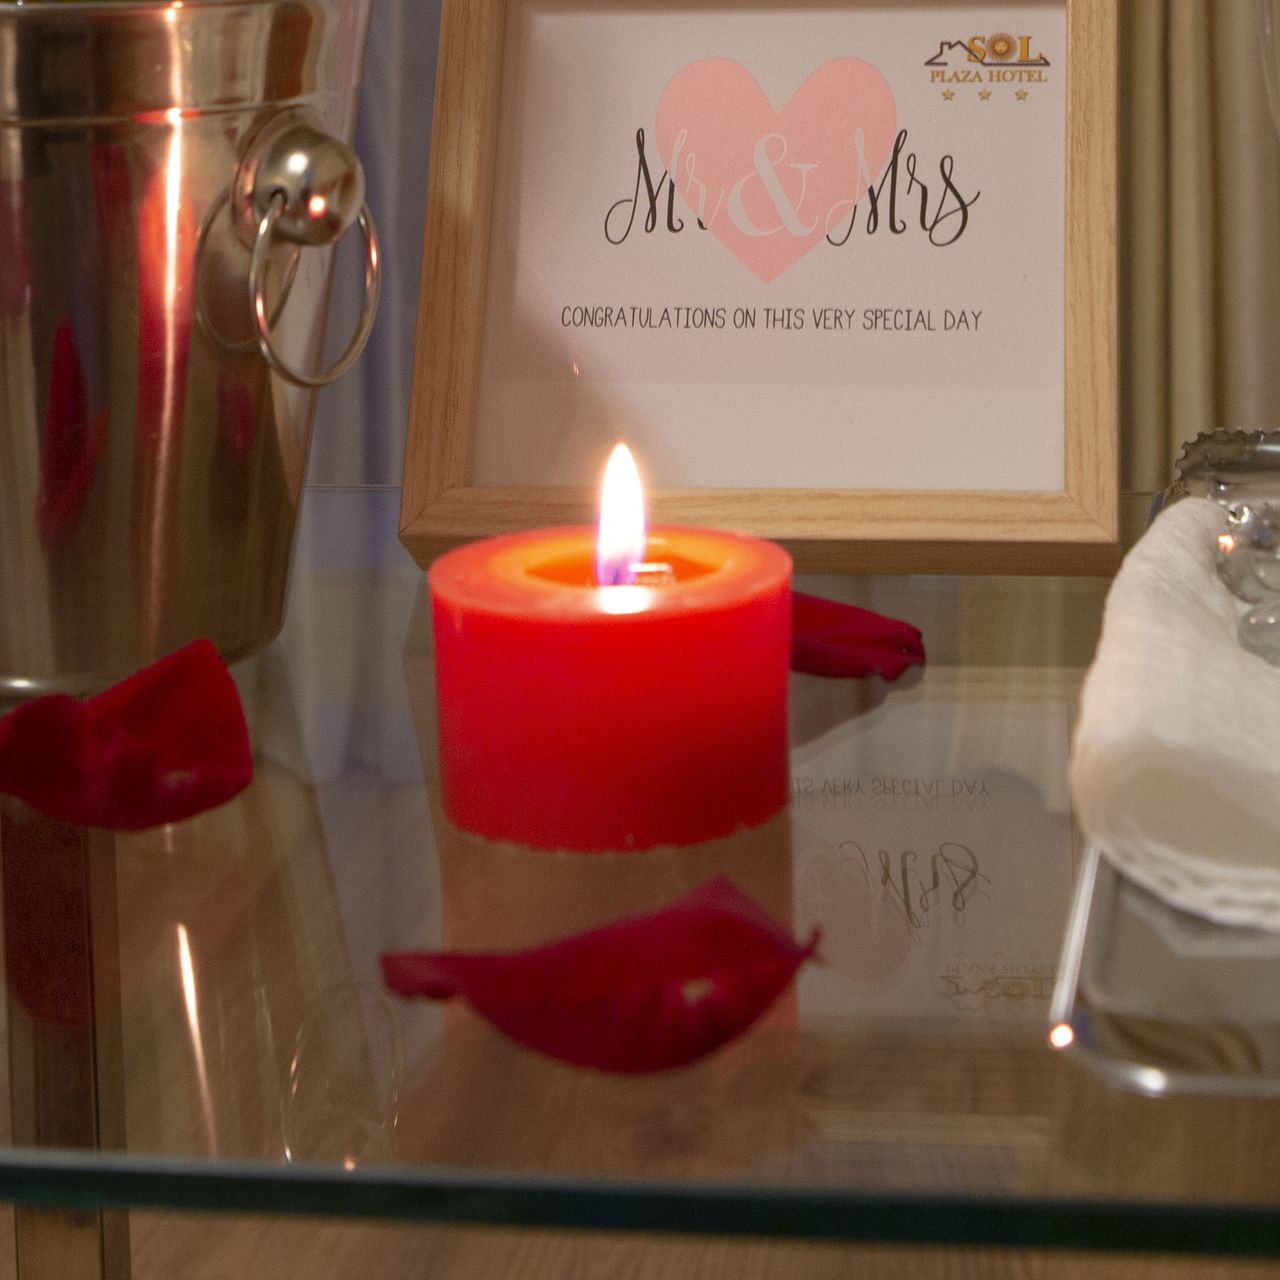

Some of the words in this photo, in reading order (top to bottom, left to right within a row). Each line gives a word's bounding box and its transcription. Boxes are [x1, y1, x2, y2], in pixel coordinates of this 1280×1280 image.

[966, 32, 1042, 62] SOL
[930, 70, 983, 83] PLAZA
[988, 70, 1048, 83] HOTEL
[605, 128, 724, 245] Mr
[727, 133, 820, 237] &
[825, 128, 981, 247] Mrs
[561, 306, 726, 329] CONGRATULATIONS
[733, 308, 756, 329] ON
[763, 308, 805, 330] THIS
[812, 308, 856, 330] VERY
[862, 309, 937, 331] SPECIAL
[944, 310, 982, 331] DAY
